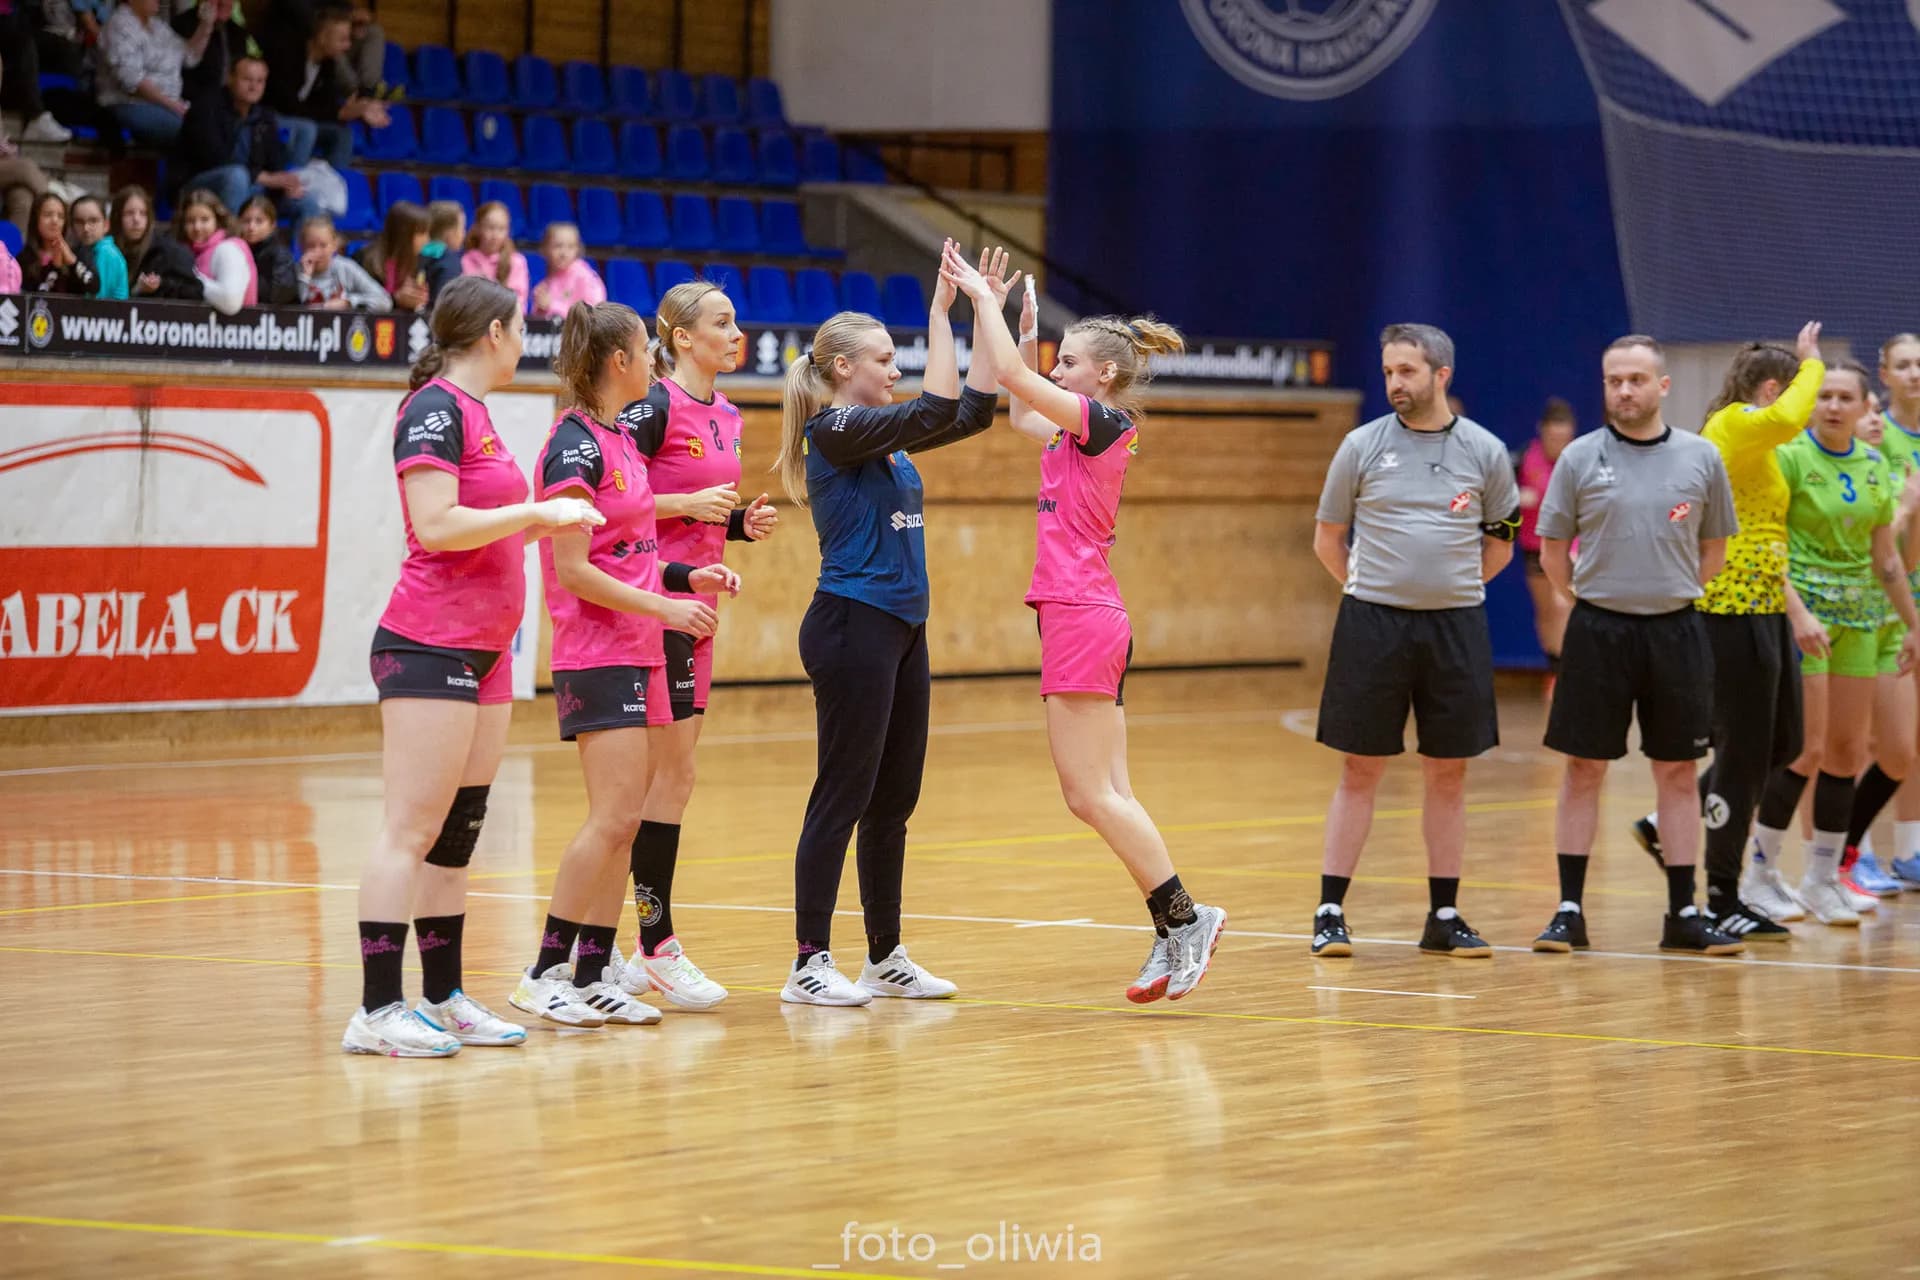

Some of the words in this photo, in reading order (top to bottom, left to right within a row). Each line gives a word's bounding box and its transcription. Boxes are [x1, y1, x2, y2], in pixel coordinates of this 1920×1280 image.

[61, 307, 341, 362] www.koronahandball.pl
[408, 425, 425, 435] Sun
[408, 431, 445, 443] Horizon
[709, 419, 725, 451] 2
[562, 449, 579, 457] Sun
[563, 455, 593, 469] Horizon
[1838, 472, 1857, 504] 3
[0, 586, 299, 661] ABELA-CK
